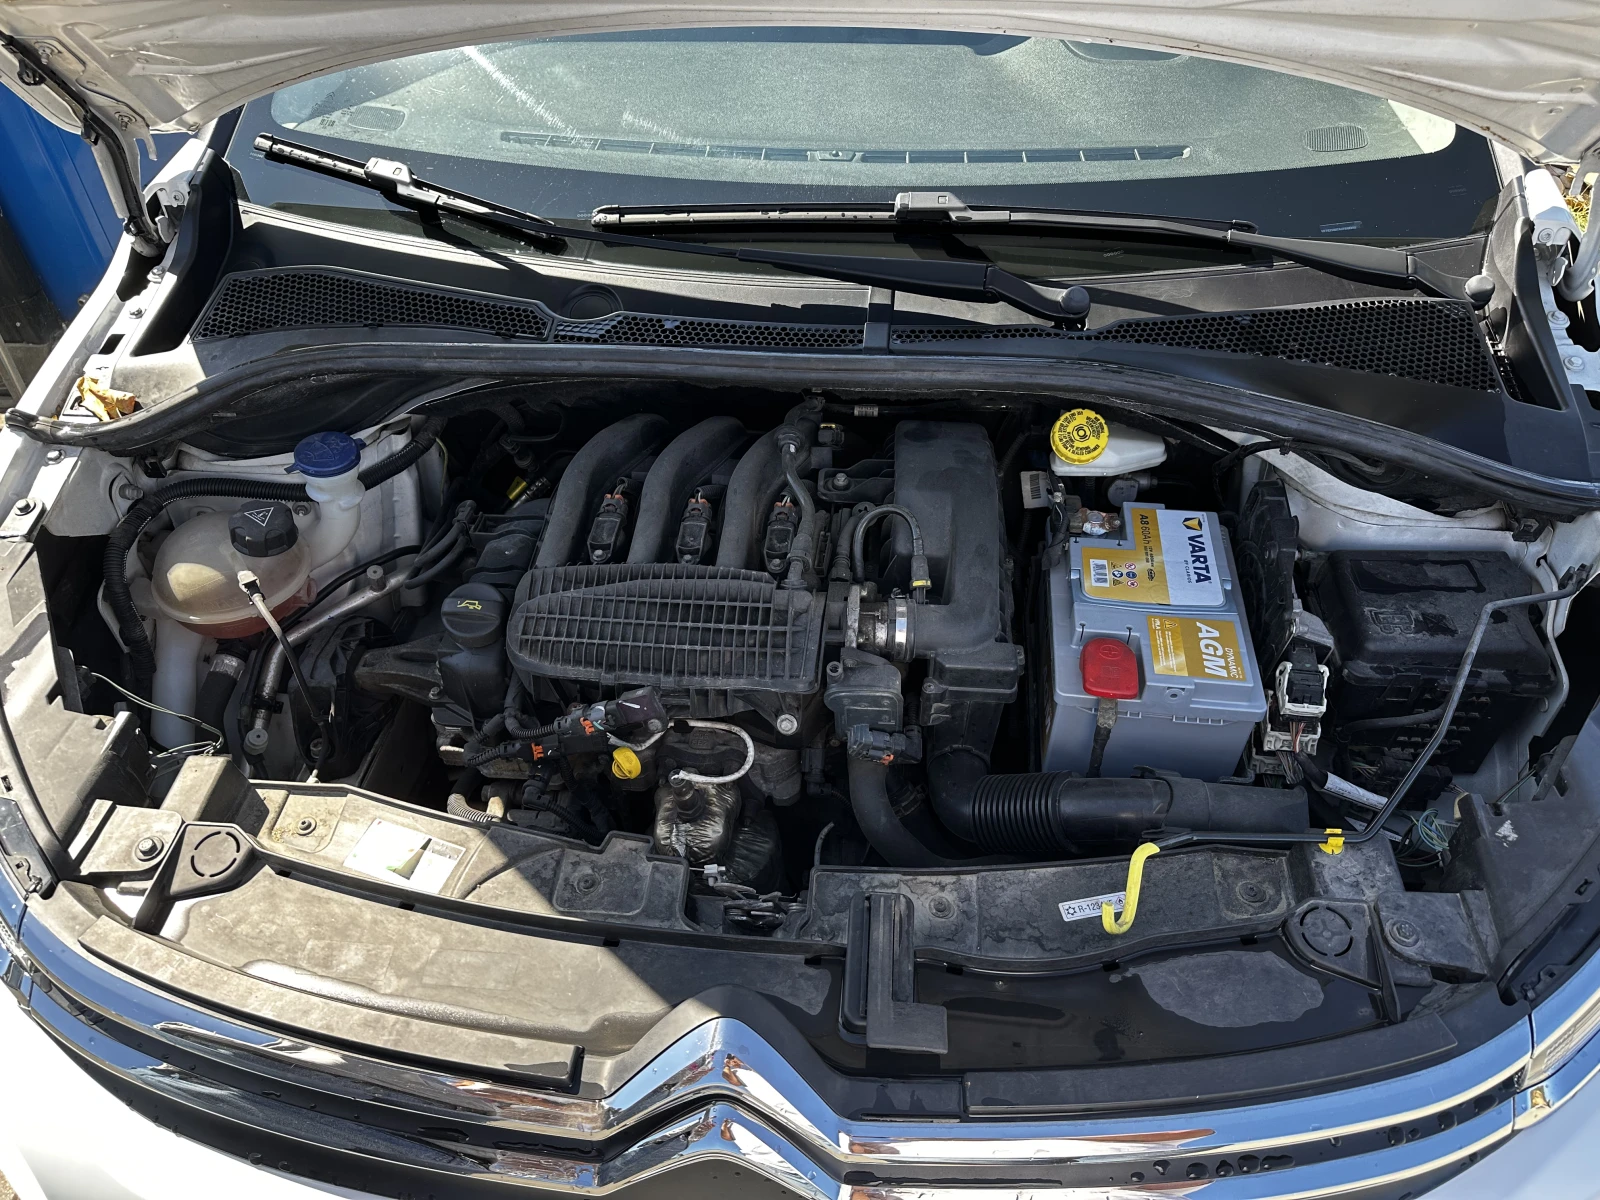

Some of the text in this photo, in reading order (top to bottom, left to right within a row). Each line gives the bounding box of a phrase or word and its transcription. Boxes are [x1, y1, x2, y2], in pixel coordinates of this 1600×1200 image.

[1139, 514, 1149, 525] A8
[1187, 534, 1211, 584] VARTA
[1196, 621, 1228, 678] AGM
[1224, 647, 1239, 678] DYNAMIC
